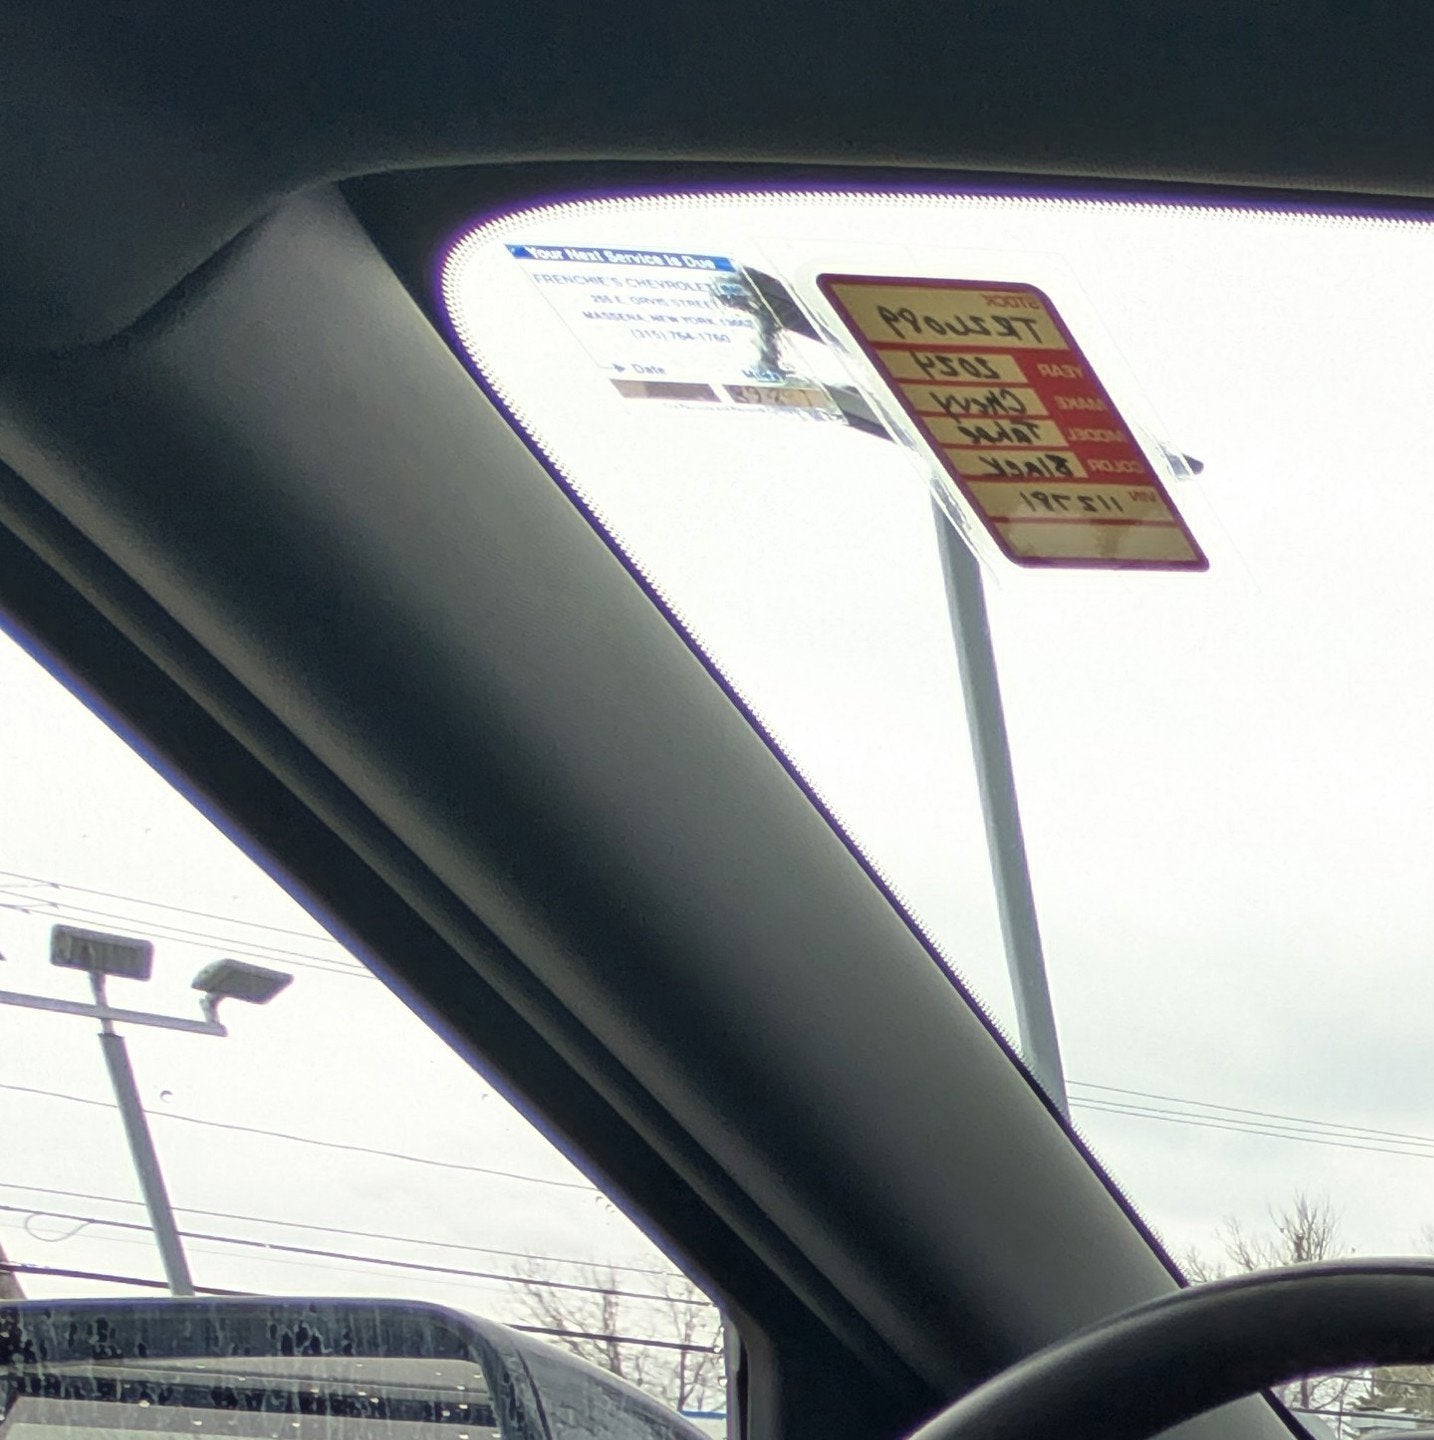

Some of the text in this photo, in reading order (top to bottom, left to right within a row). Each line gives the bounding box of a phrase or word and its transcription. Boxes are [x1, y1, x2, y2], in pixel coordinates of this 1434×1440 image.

[523, 246, 564, 260] Your
[566, 248, 604, 262] Next
[604, 250, 663, 265] Service
[683, 256, 716, 269] Due
[532, 273, 623, 288] FRENCHIE'S
[631, 363, 666, 375] Date
